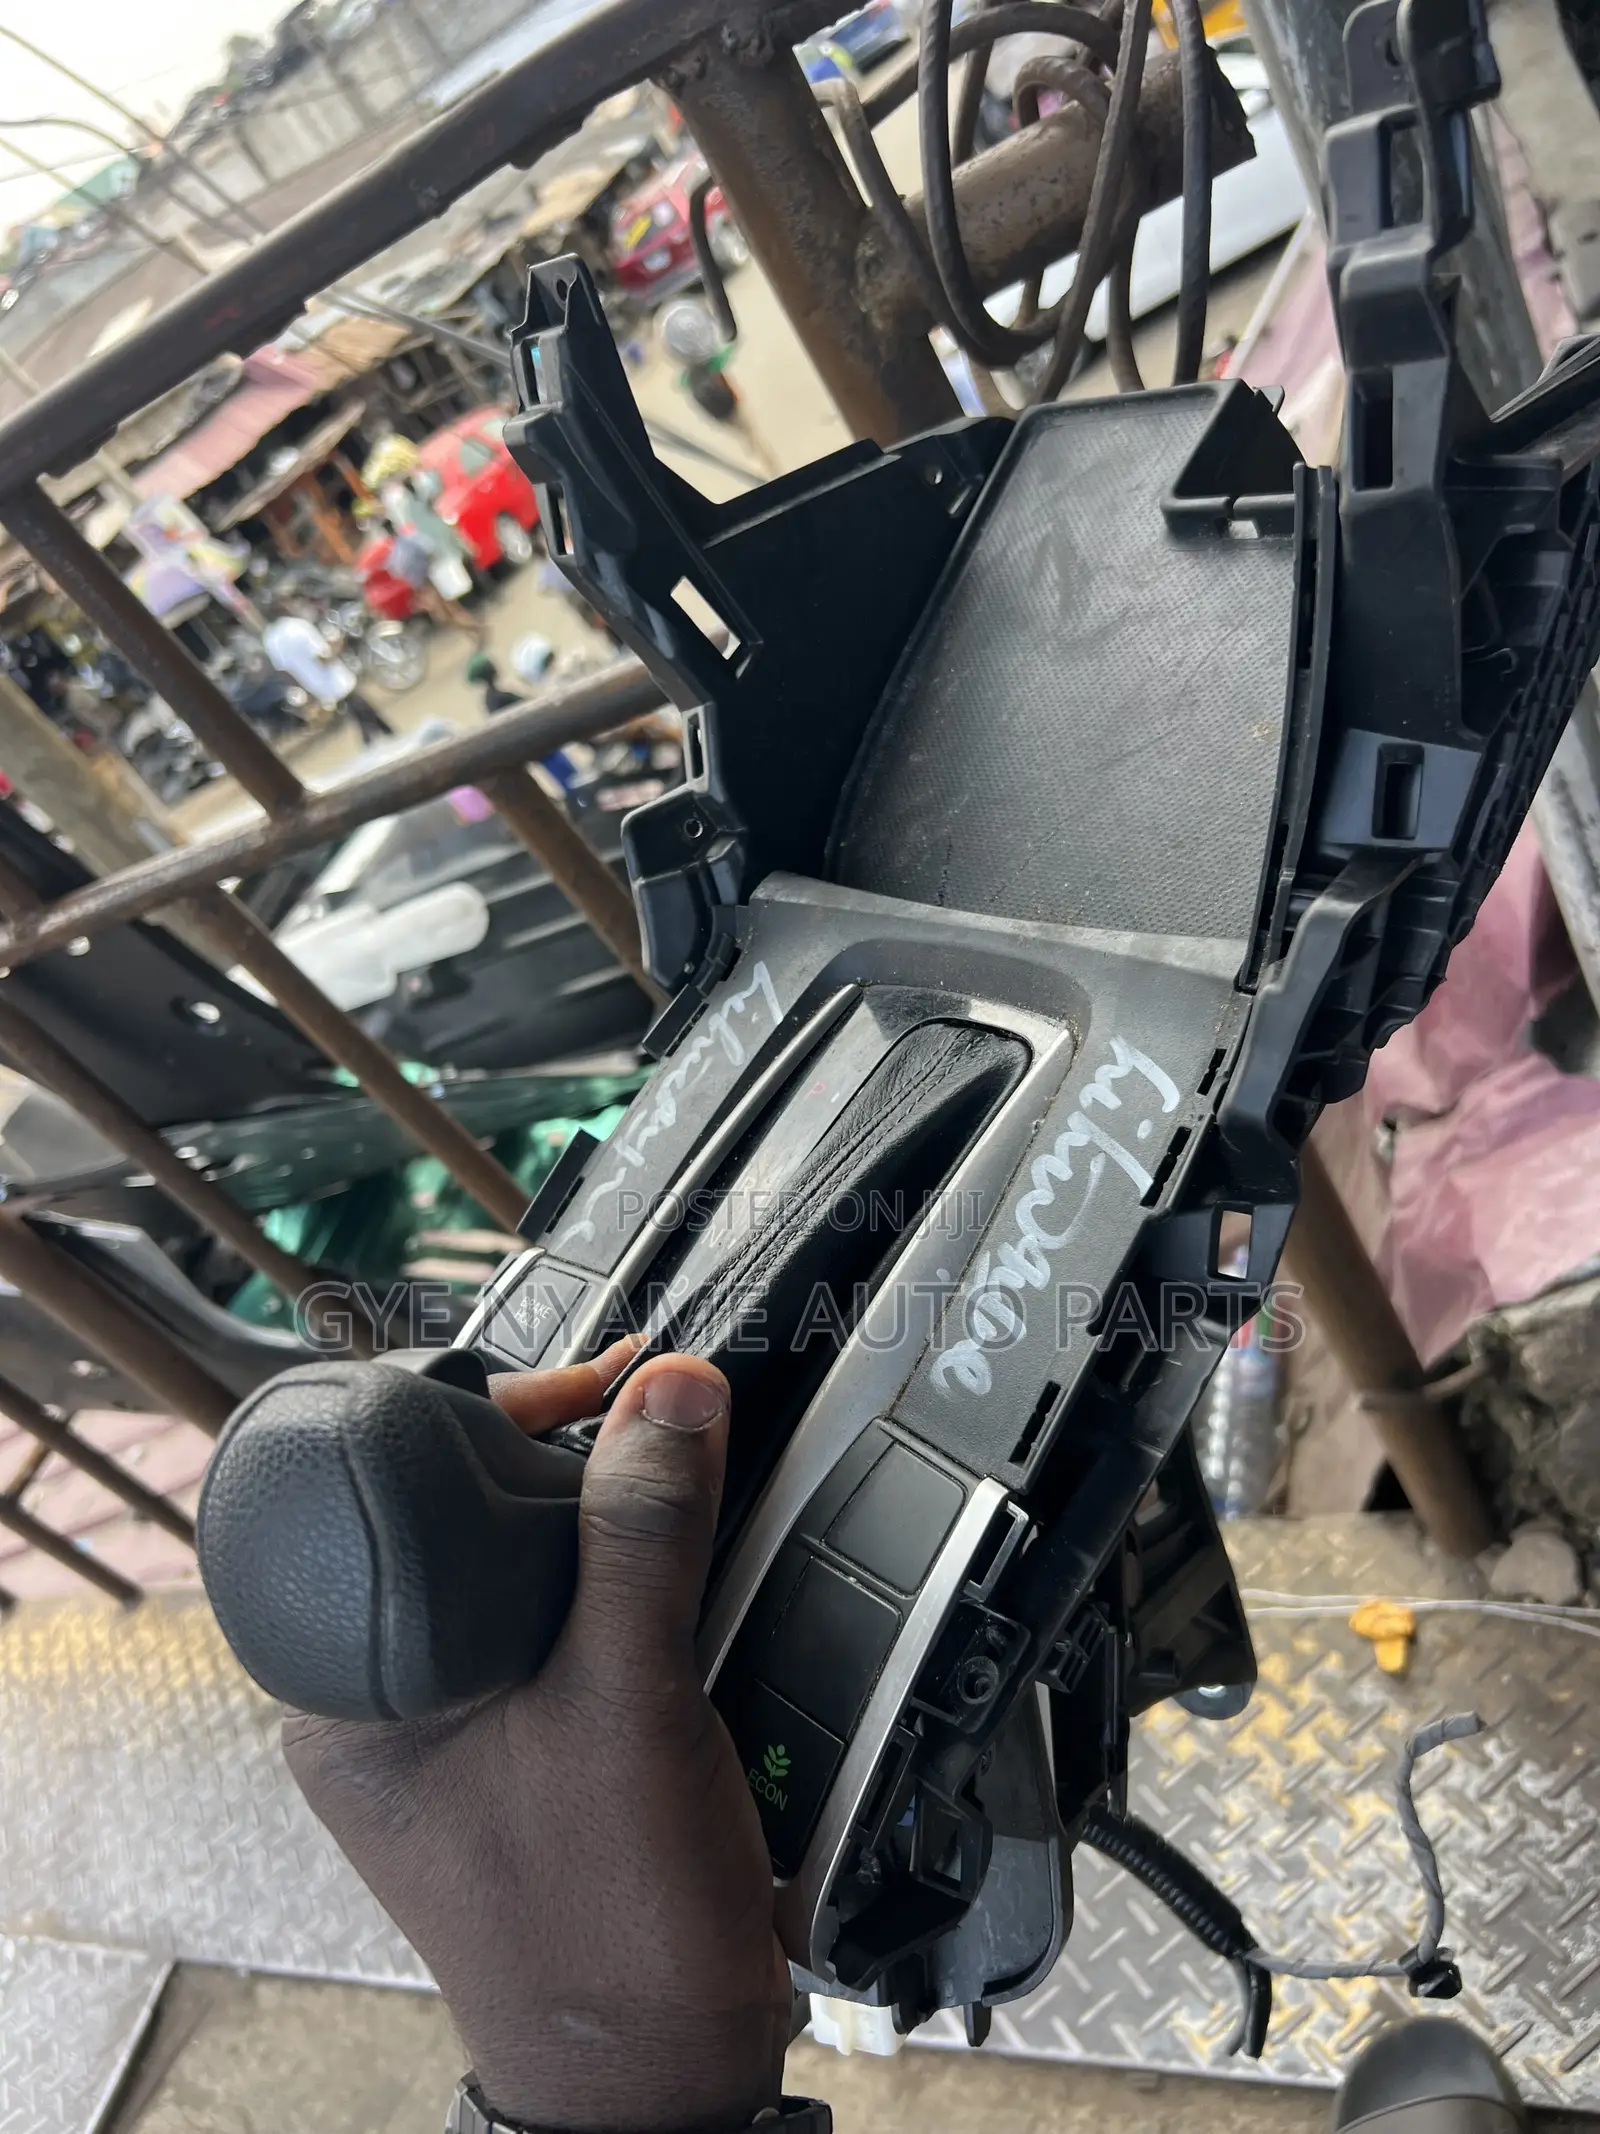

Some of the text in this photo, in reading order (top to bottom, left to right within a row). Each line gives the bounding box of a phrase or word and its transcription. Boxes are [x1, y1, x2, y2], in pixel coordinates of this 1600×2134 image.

[804, 1081, 826, 1100] P
[514, 1308, 541, 1329] HOLD
[520, 1296, 553, 1319] BRAKE
[747, 1768, 788, 1811] ECON
